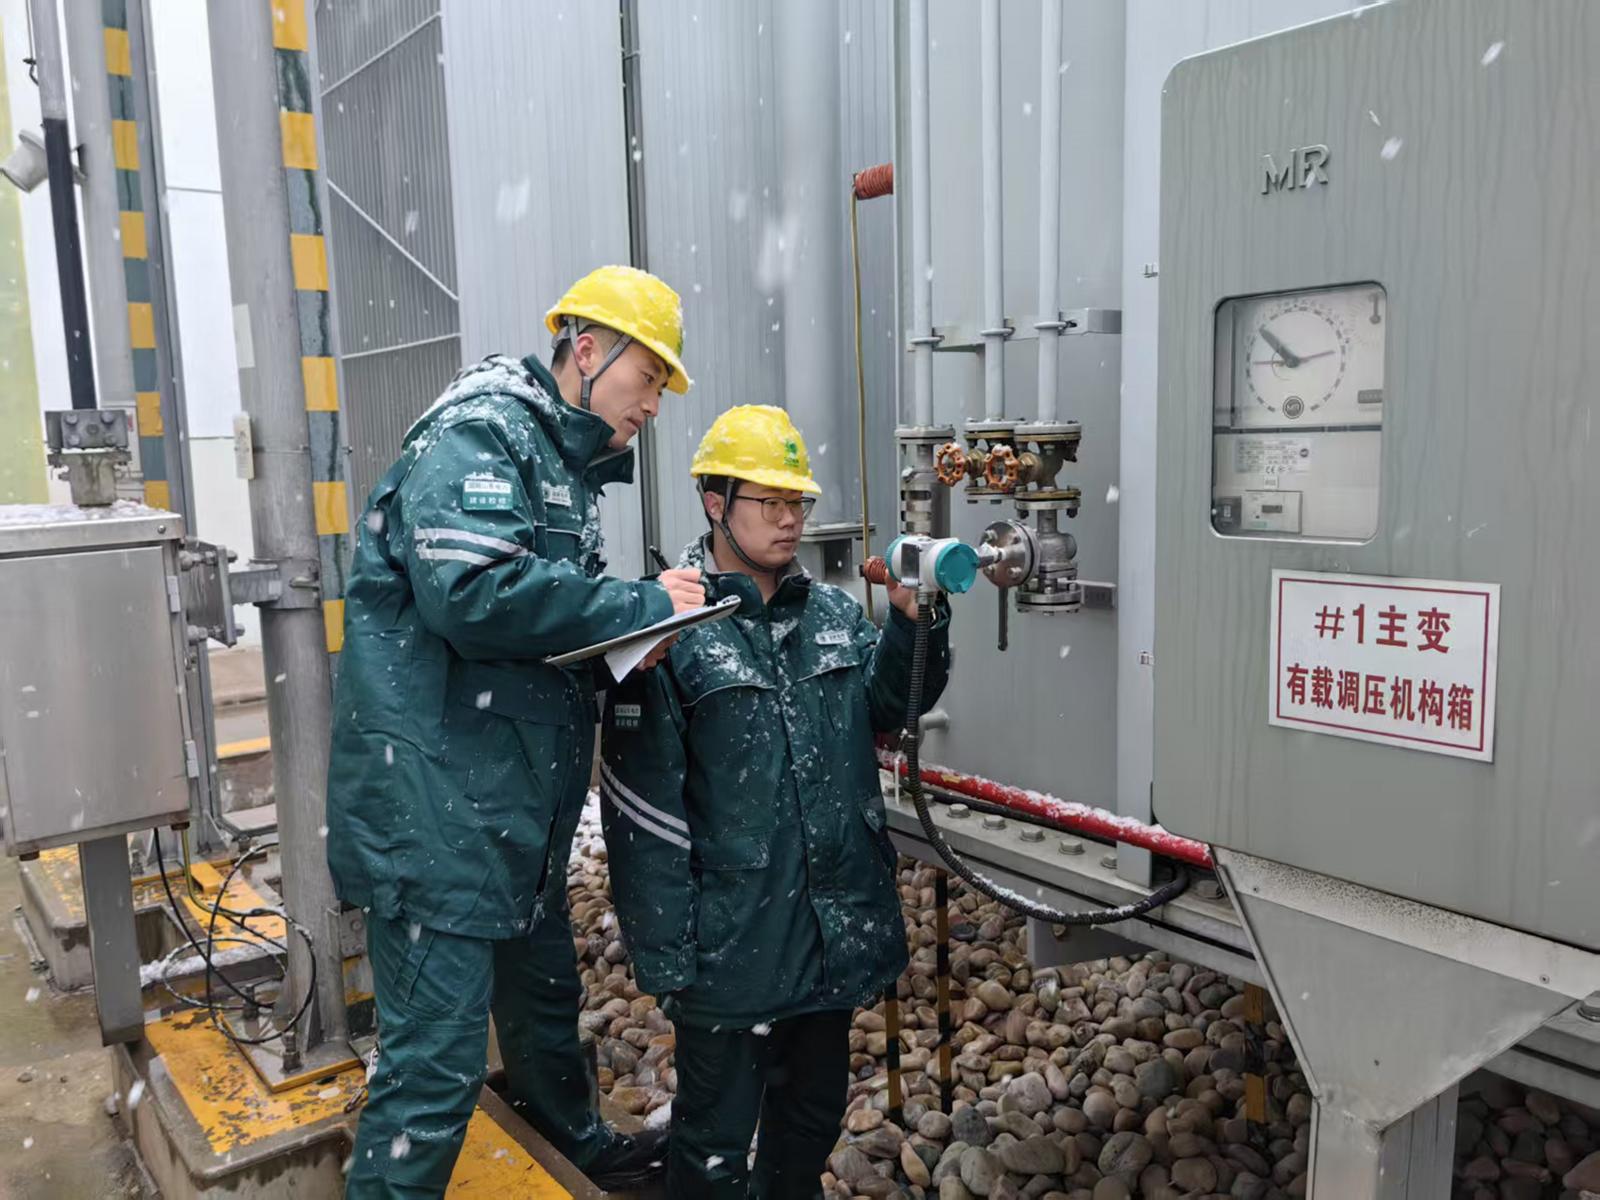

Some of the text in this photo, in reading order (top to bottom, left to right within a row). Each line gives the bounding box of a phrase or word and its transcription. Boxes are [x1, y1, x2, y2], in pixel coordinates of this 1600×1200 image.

[1261, 144, 1329, 195] MR
[1314, 604, 1450, 654] #1主变
[1286, 663, 1474, 732] 有载调压机构箱
